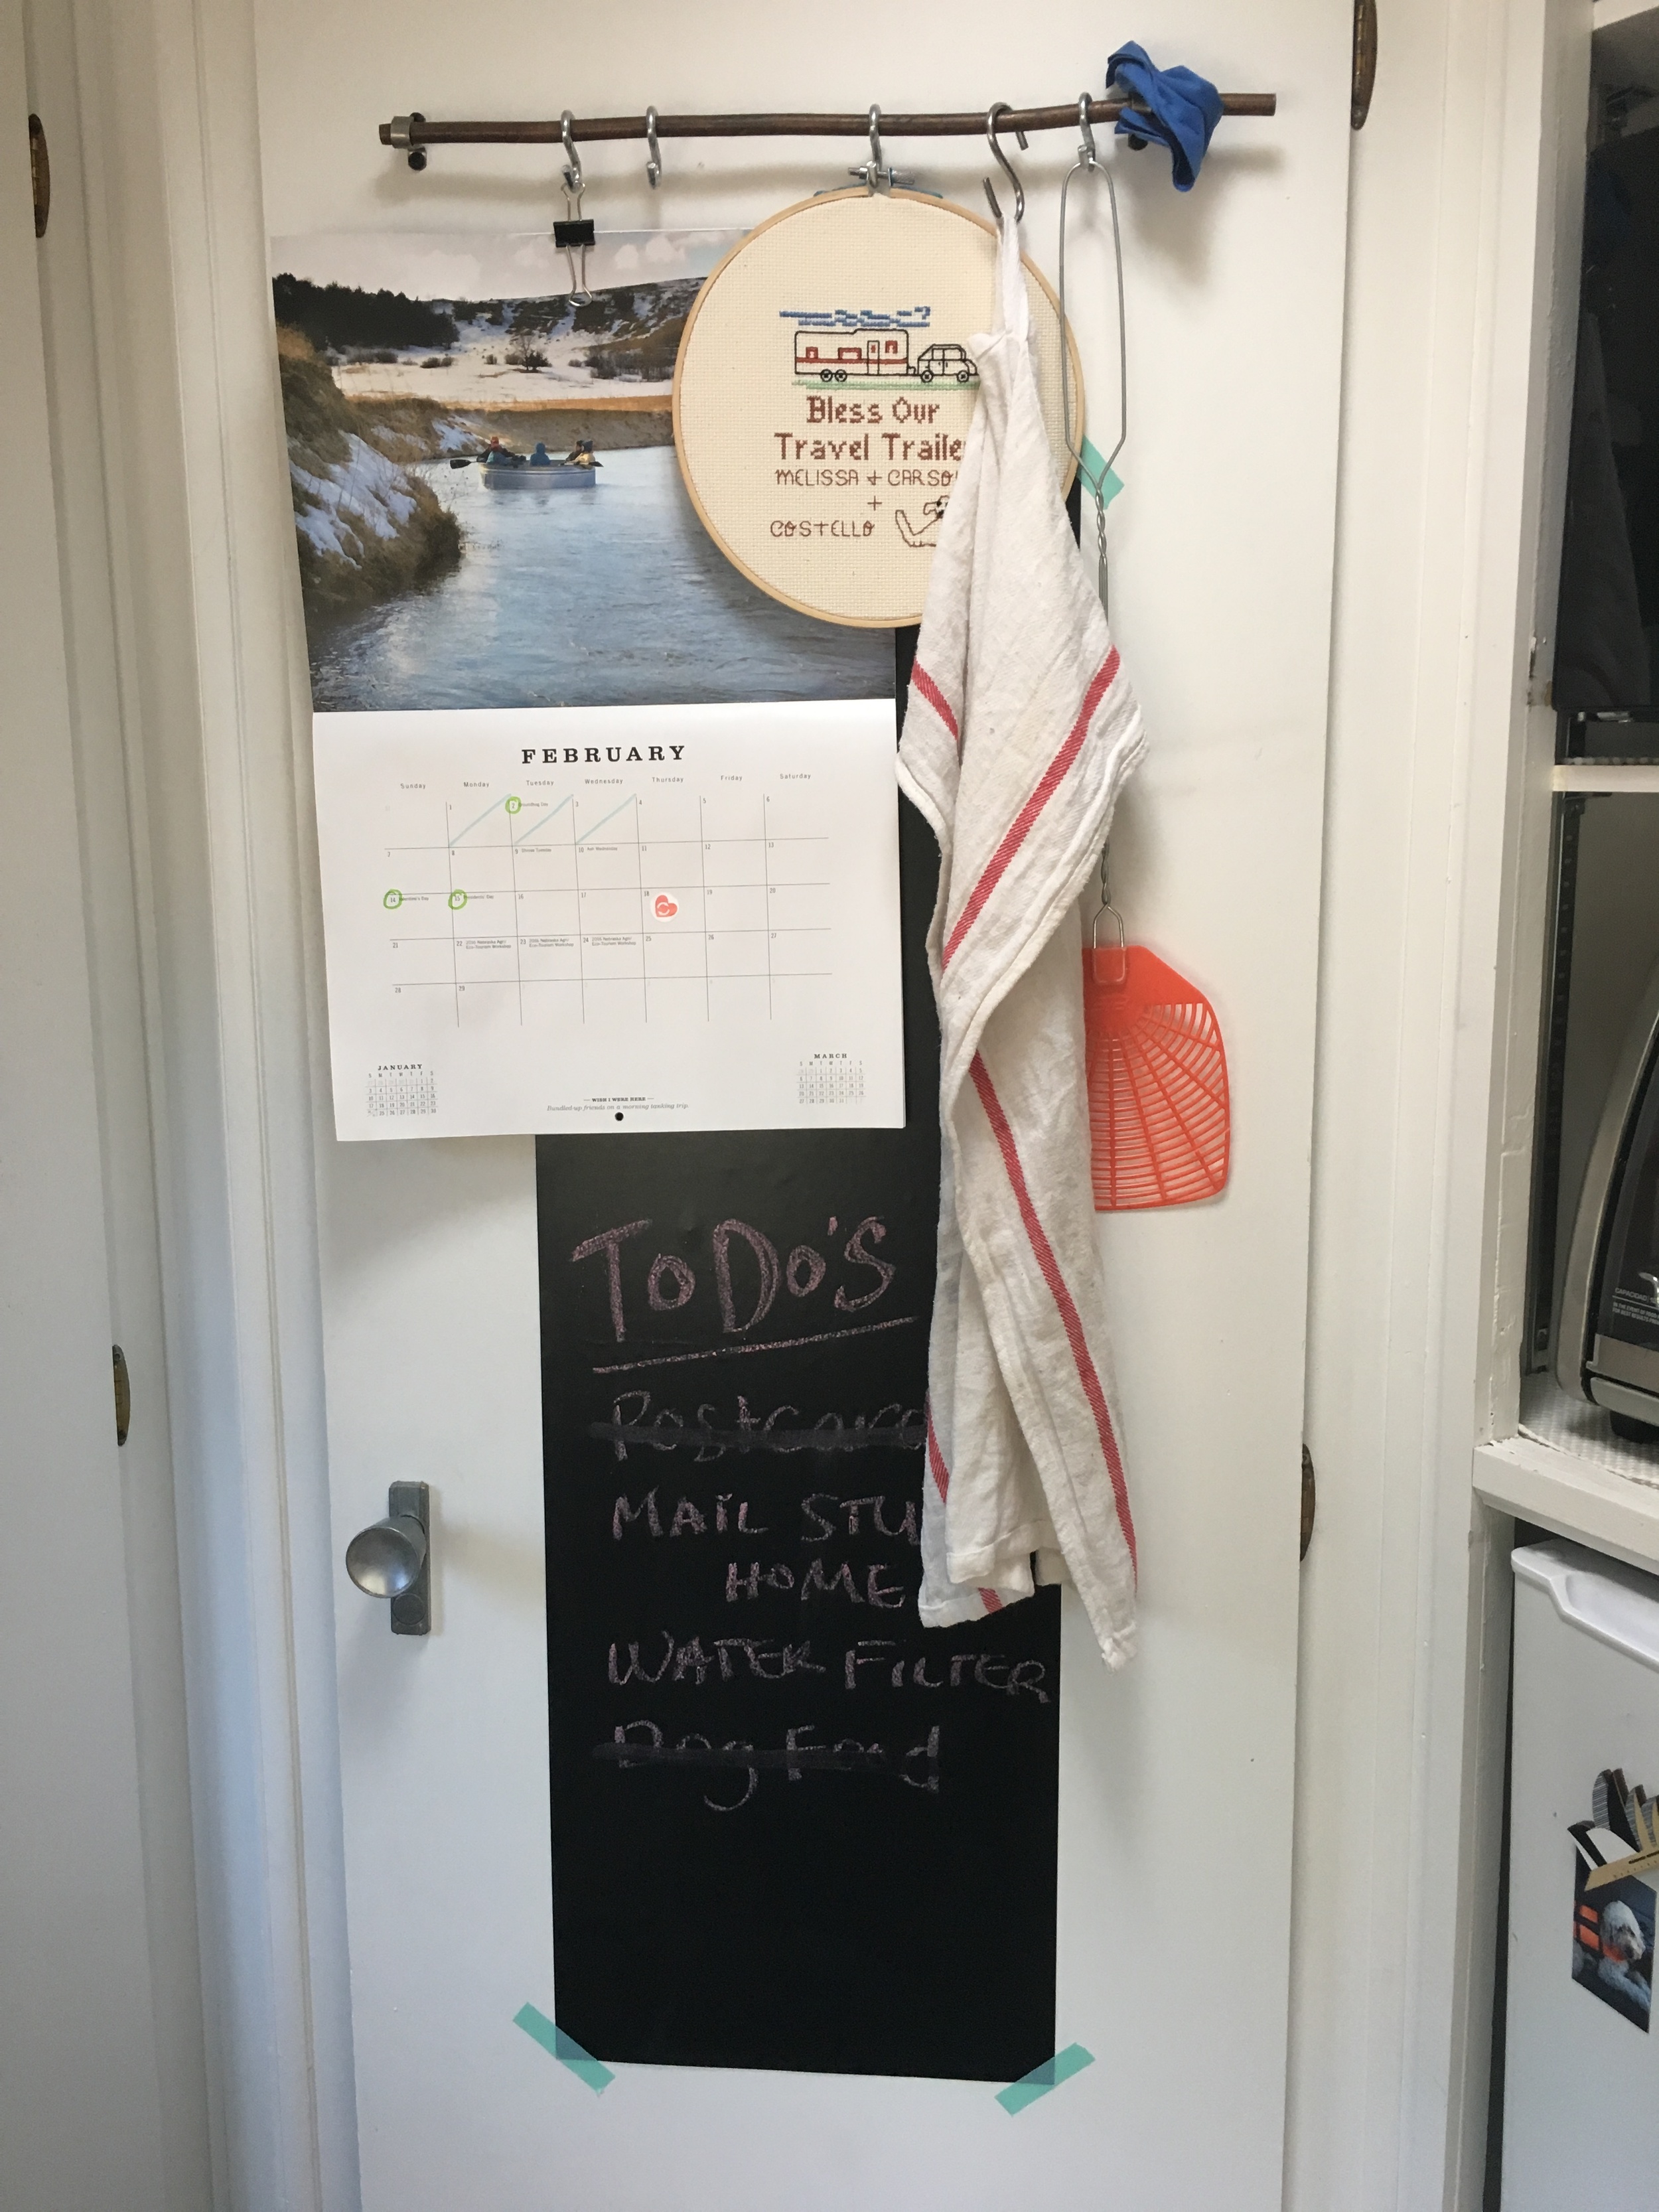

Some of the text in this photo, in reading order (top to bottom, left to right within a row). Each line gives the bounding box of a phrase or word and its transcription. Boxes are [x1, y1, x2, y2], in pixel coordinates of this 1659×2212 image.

[806, 396, 940, 423] Bless Our
[774, 433, 966, 461] Travel Traile
[776, 469, 859, 486] MELISSA
[867, 496, 882, 511] +
[770, 520, 875, 537] COSTELLO
[522, 745, 685, 764] FEBRUARY
[726, 1558, 906, 1608] HOME
[607, 1631, 826, 1686] WATER
